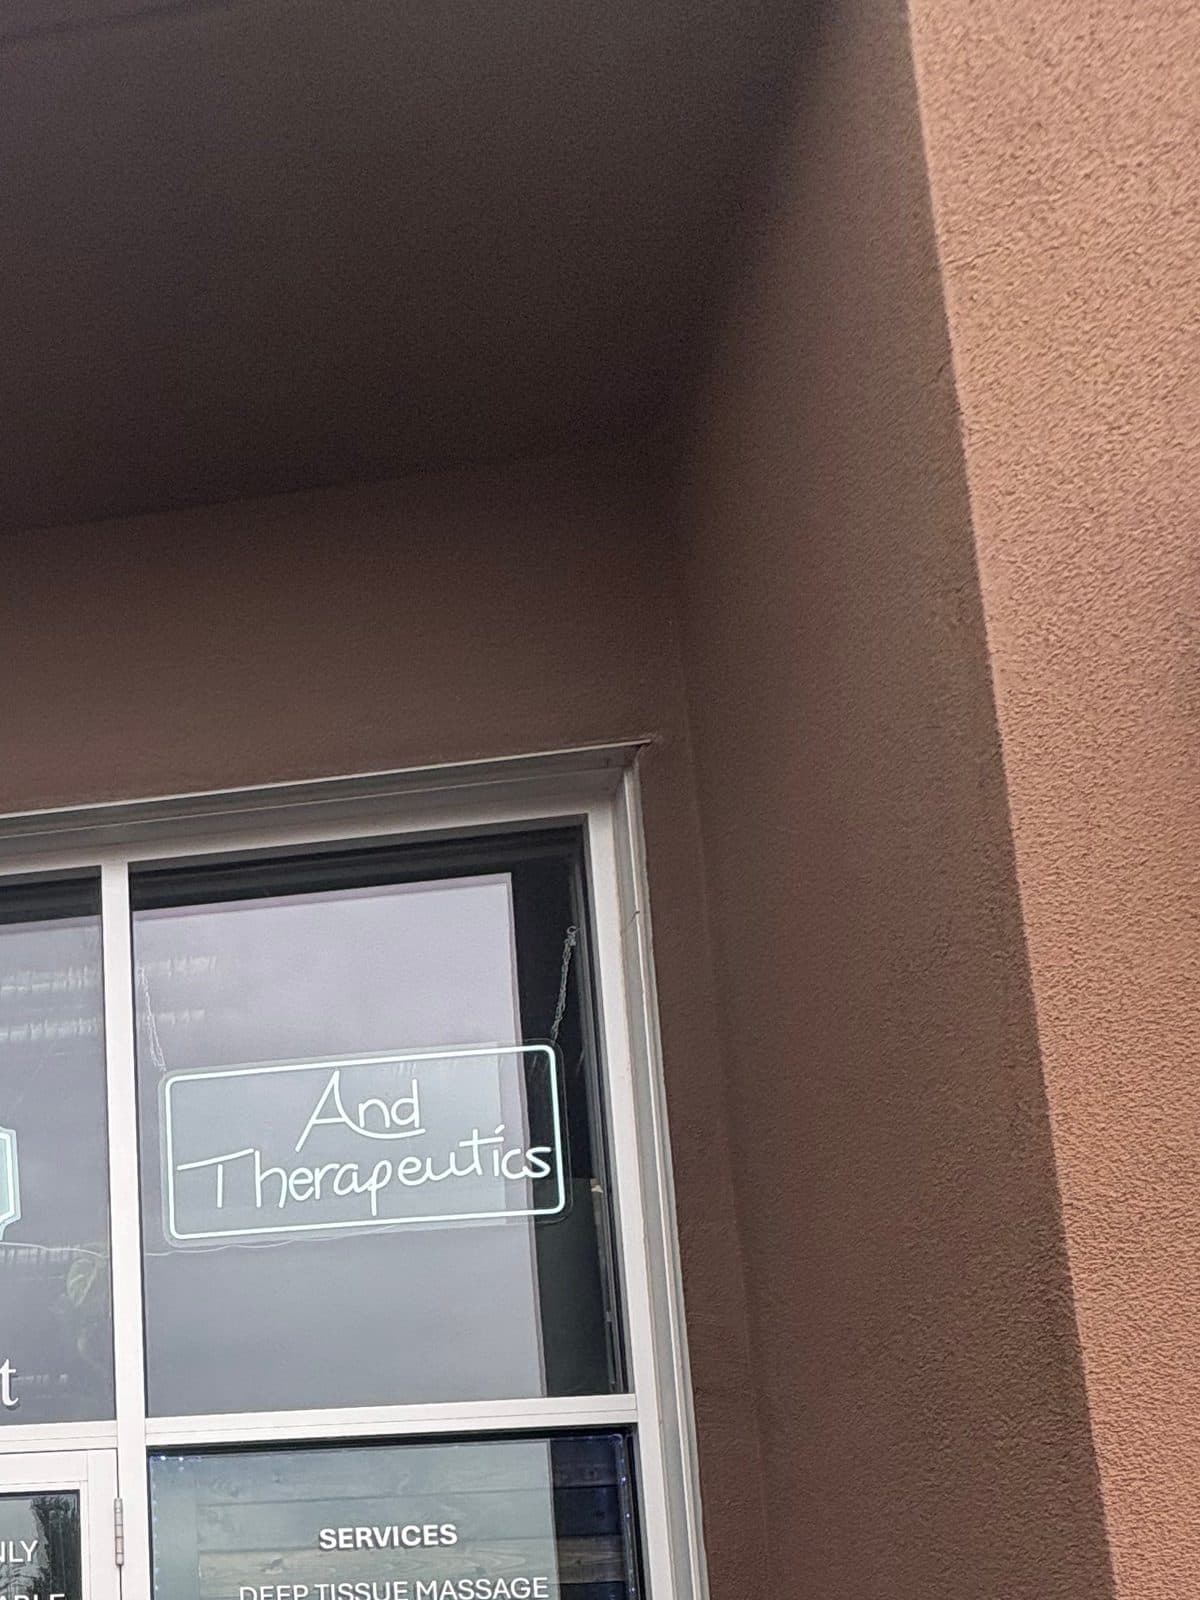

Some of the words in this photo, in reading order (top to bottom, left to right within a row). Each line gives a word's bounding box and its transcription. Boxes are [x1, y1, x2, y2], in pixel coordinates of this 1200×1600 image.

[296, 1070, 426, 1152] And
[177, 1124, 552, 1216] Therapeutics
[319, 1524, 458, 1549] SERVICES
